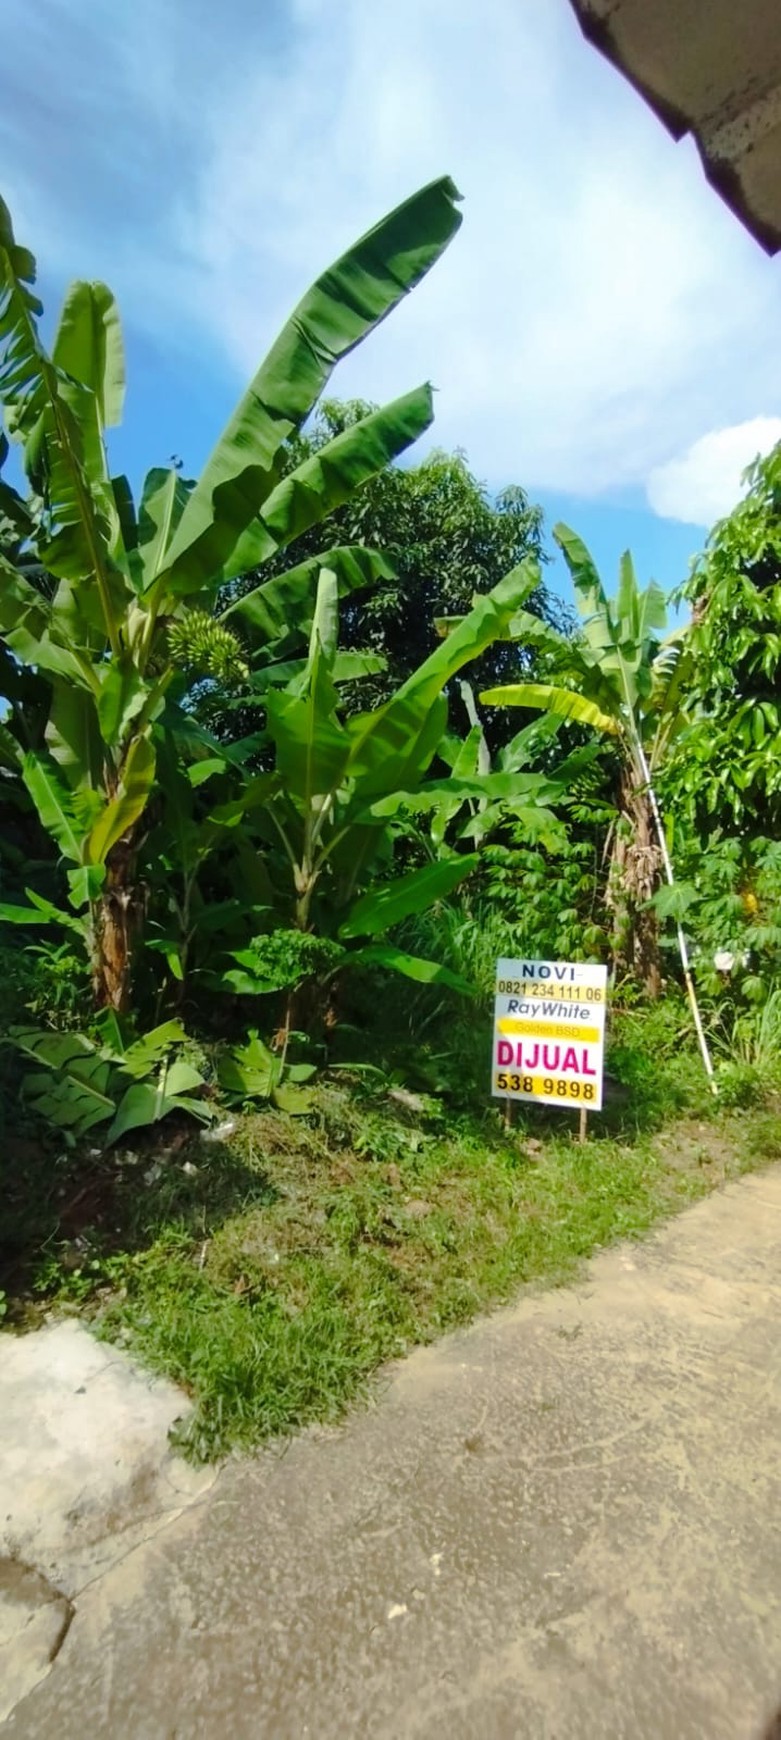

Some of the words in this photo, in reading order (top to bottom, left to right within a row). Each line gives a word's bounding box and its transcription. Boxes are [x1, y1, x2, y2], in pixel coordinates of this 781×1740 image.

[522, 964, 575, 981] NOVI
[498, 981, 527, 995] 0821
[532, 983, 554, 997] 234
[559, 985, 580, 1000] 111
[586, 987, 601, 1001] 06
[515, 1021, 553, 1036] Golden
[556, 1024, 580, 1037] BSD
[497, 1040, 596, 1075] DIJUAL
[497, 1073, 533, 1093] 538
[543, 1078, 594, 1100] 9898
